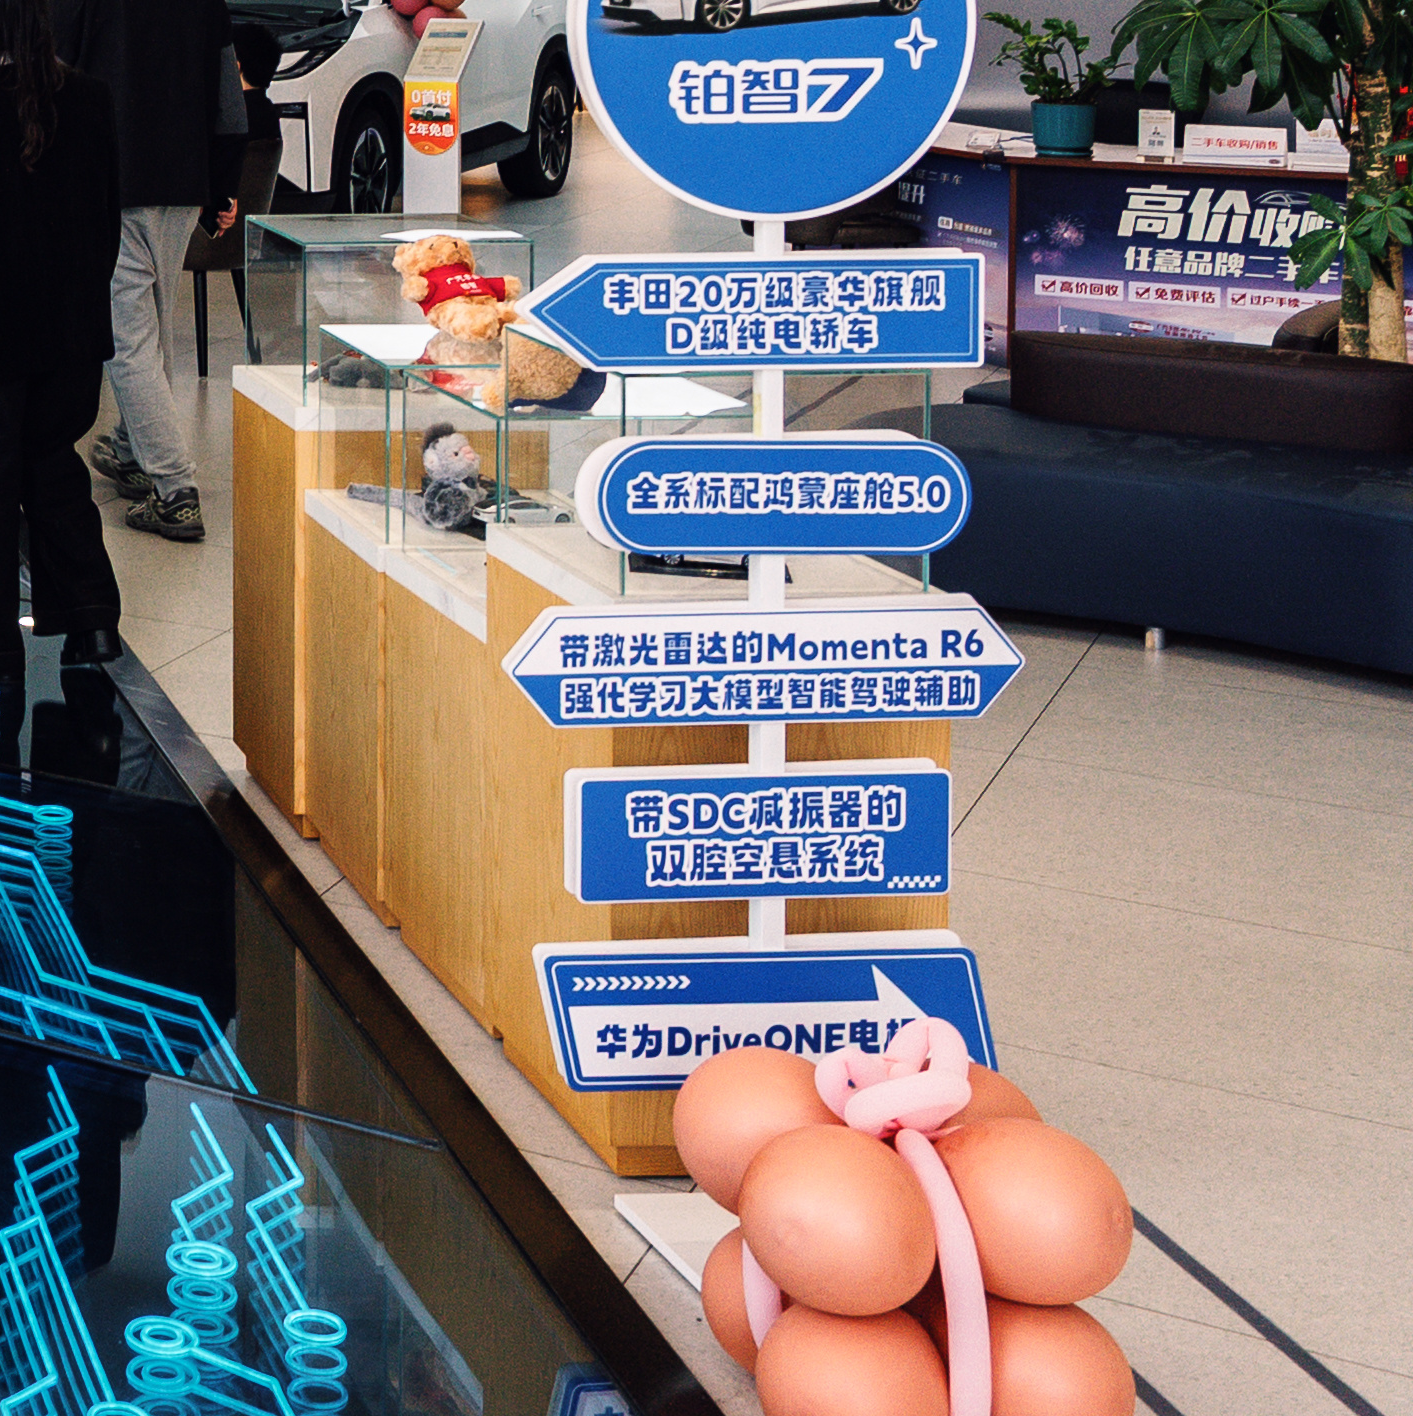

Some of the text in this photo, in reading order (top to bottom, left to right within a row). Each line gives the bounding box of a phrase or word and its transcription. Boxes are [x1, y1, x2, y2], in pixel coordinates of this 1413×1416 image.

[411, 89, 452, 106] 0首付
[674, 63, 879, 119] 铂智7
[408, 122, 455, 138] 2年免息
[607, 271, 942, 312] 丰田20万级豪华旗舰
[1059, 280, 1120, 298] 高价回收
[1154, 287, 1216, 305] 免费评估
[670, 317, 878, 353] D级纯电轿车
[629, 472, 951, 513] 全系标配鸿蒙座舱5.0
[560, 629, 985, 668] 带激光雷达的Momenta R6
[562, 672, 980, 717] 强化学习大模型智能驾驶辅助
[627, 787, 905, 837] 带SDC减振器的
[648, 838, 885, 884] 双腔空悬系统
